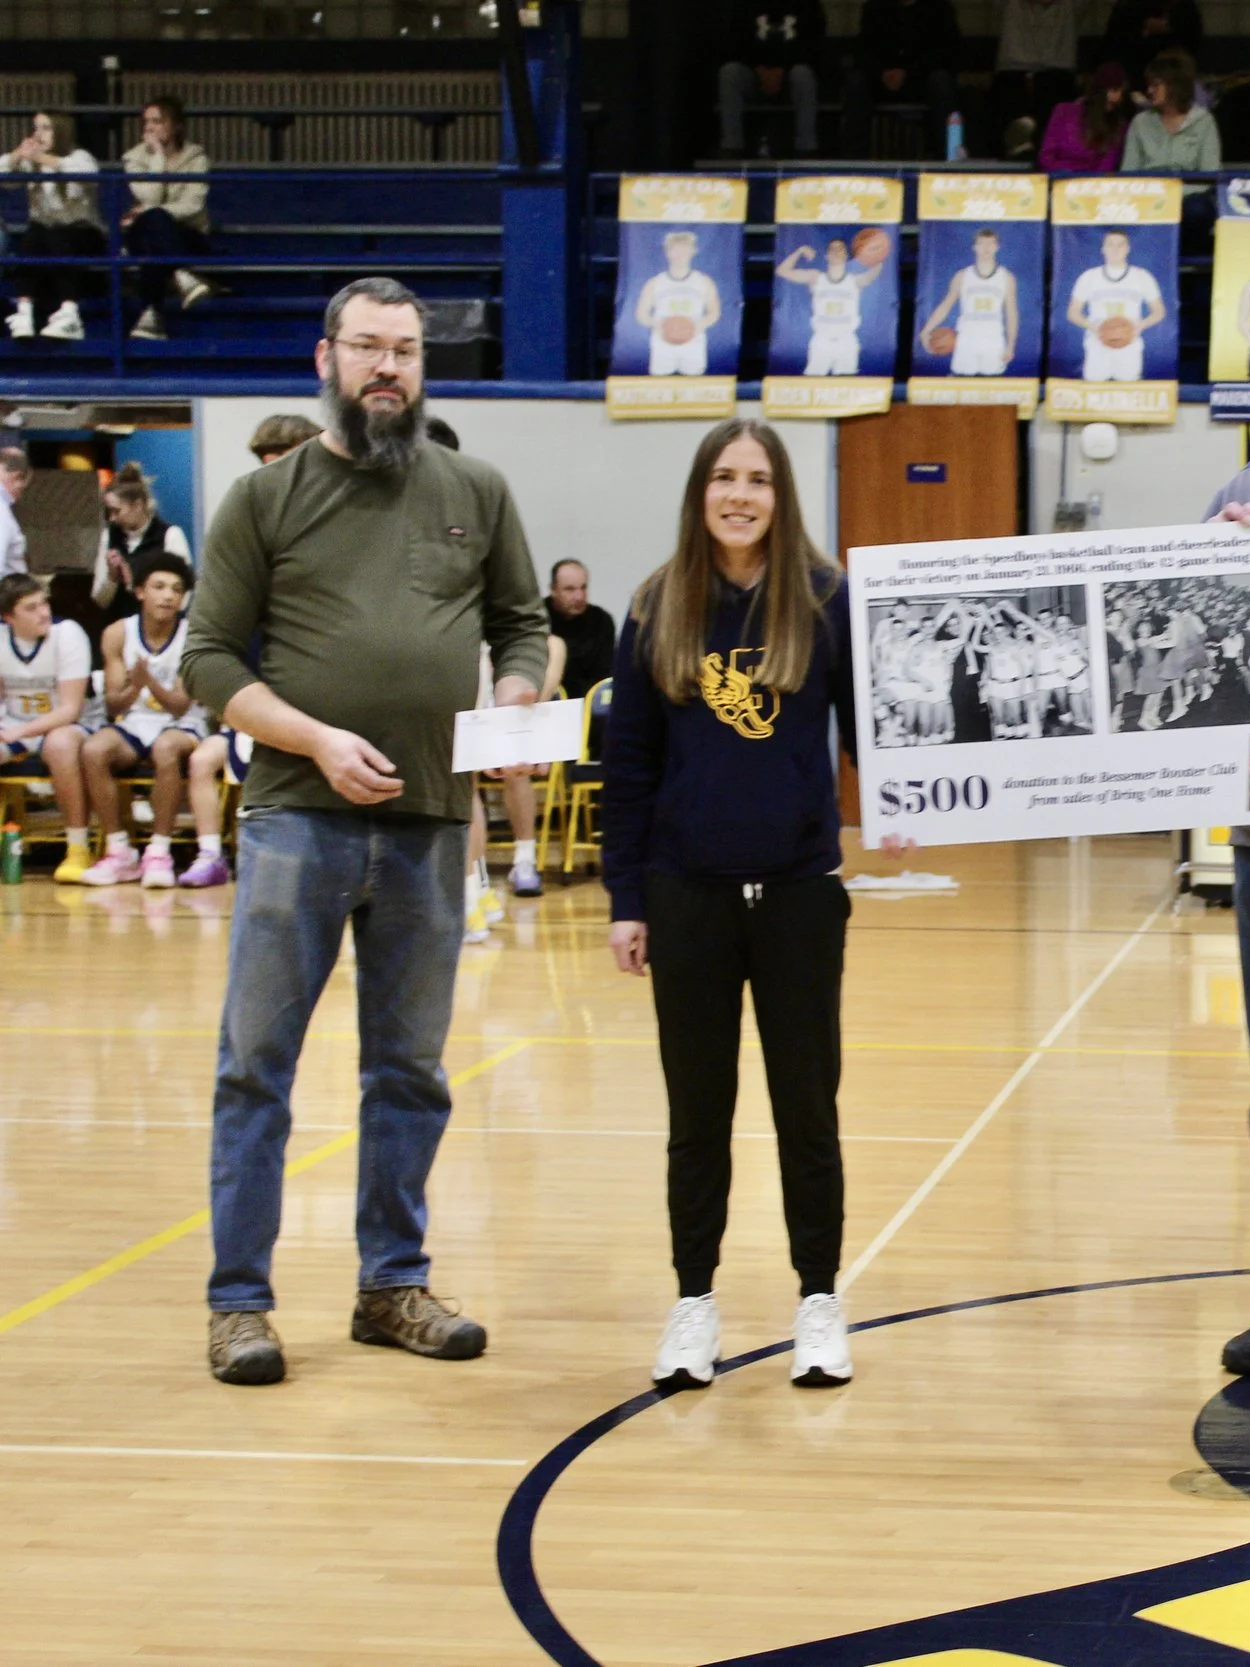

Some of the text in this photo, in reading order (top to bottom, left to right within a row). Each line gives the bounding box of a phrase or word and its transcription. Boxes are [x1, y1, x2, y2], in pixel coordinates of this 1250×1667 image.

[1150, 541, 1173, 553] and
[878, 774, 989, 817] $500
[1002, 773, 1058, 789] donation
[1208, 762, 1239, 777] Club
